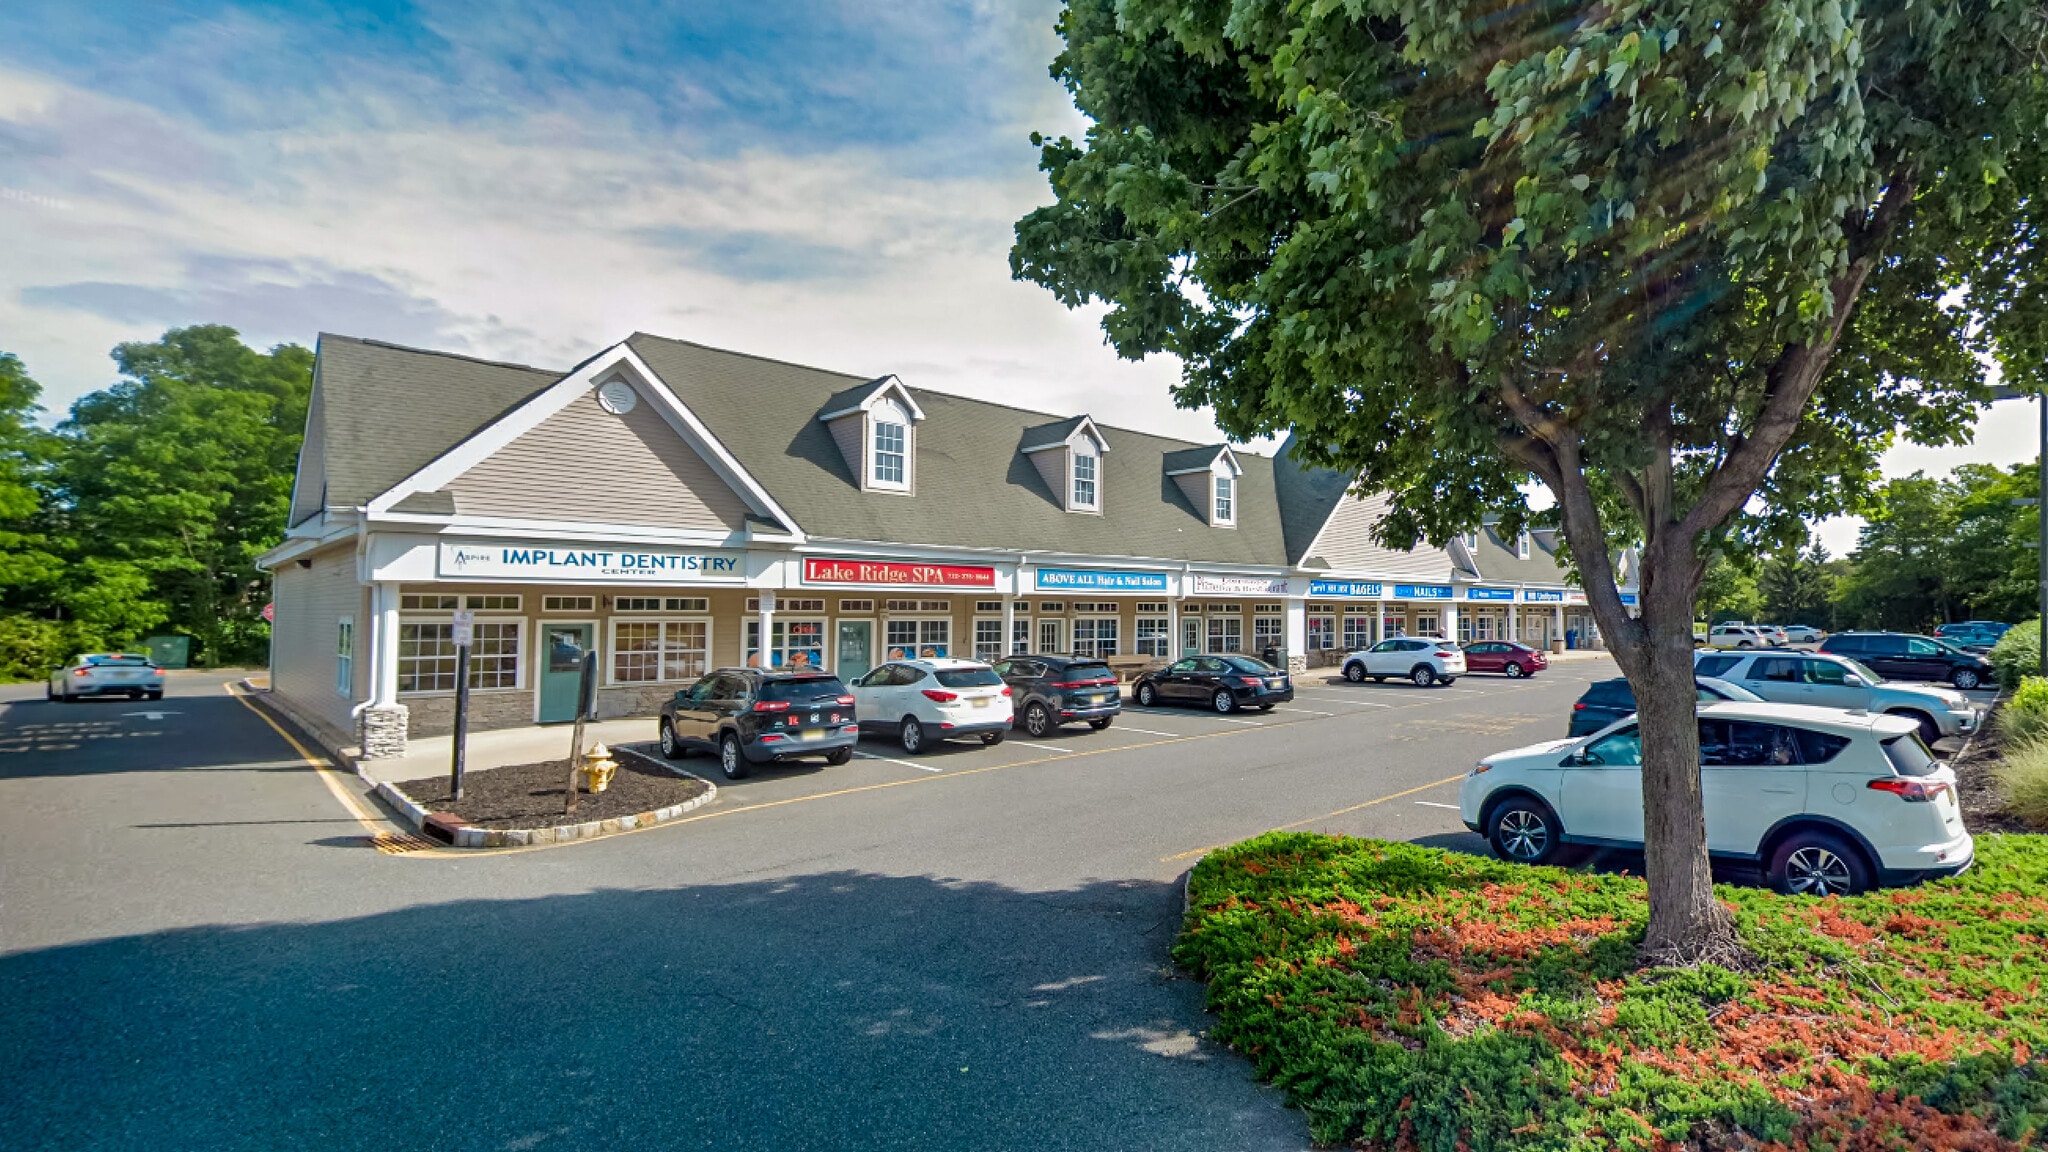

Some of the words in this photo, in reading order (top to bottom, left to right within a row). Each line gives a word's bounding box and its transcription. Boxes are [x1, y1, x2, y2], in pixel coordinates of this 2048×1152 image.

[503, 548, 613, 567] IMPLANT
[621, 553, 738, 571] DENTISTRY
[809, 562, 854, 581] Lake
[859, 564, 908, 583] Ridge
[912, 567, 945, 583] SPA
[1042, 573, 1076, 584] ABOVE
[1076, 575, 1094, 585] ALL
[1097, 575, 1114, 586] Hair
[1116, 576, 1123, 586] &
[1125, 576, 1140, 586] Nail
[1142, 576, 1162, 586] Salon
[1350, 583, 1381, 595] BAGELS
[1414, 586, 1438, 597] NAILS
